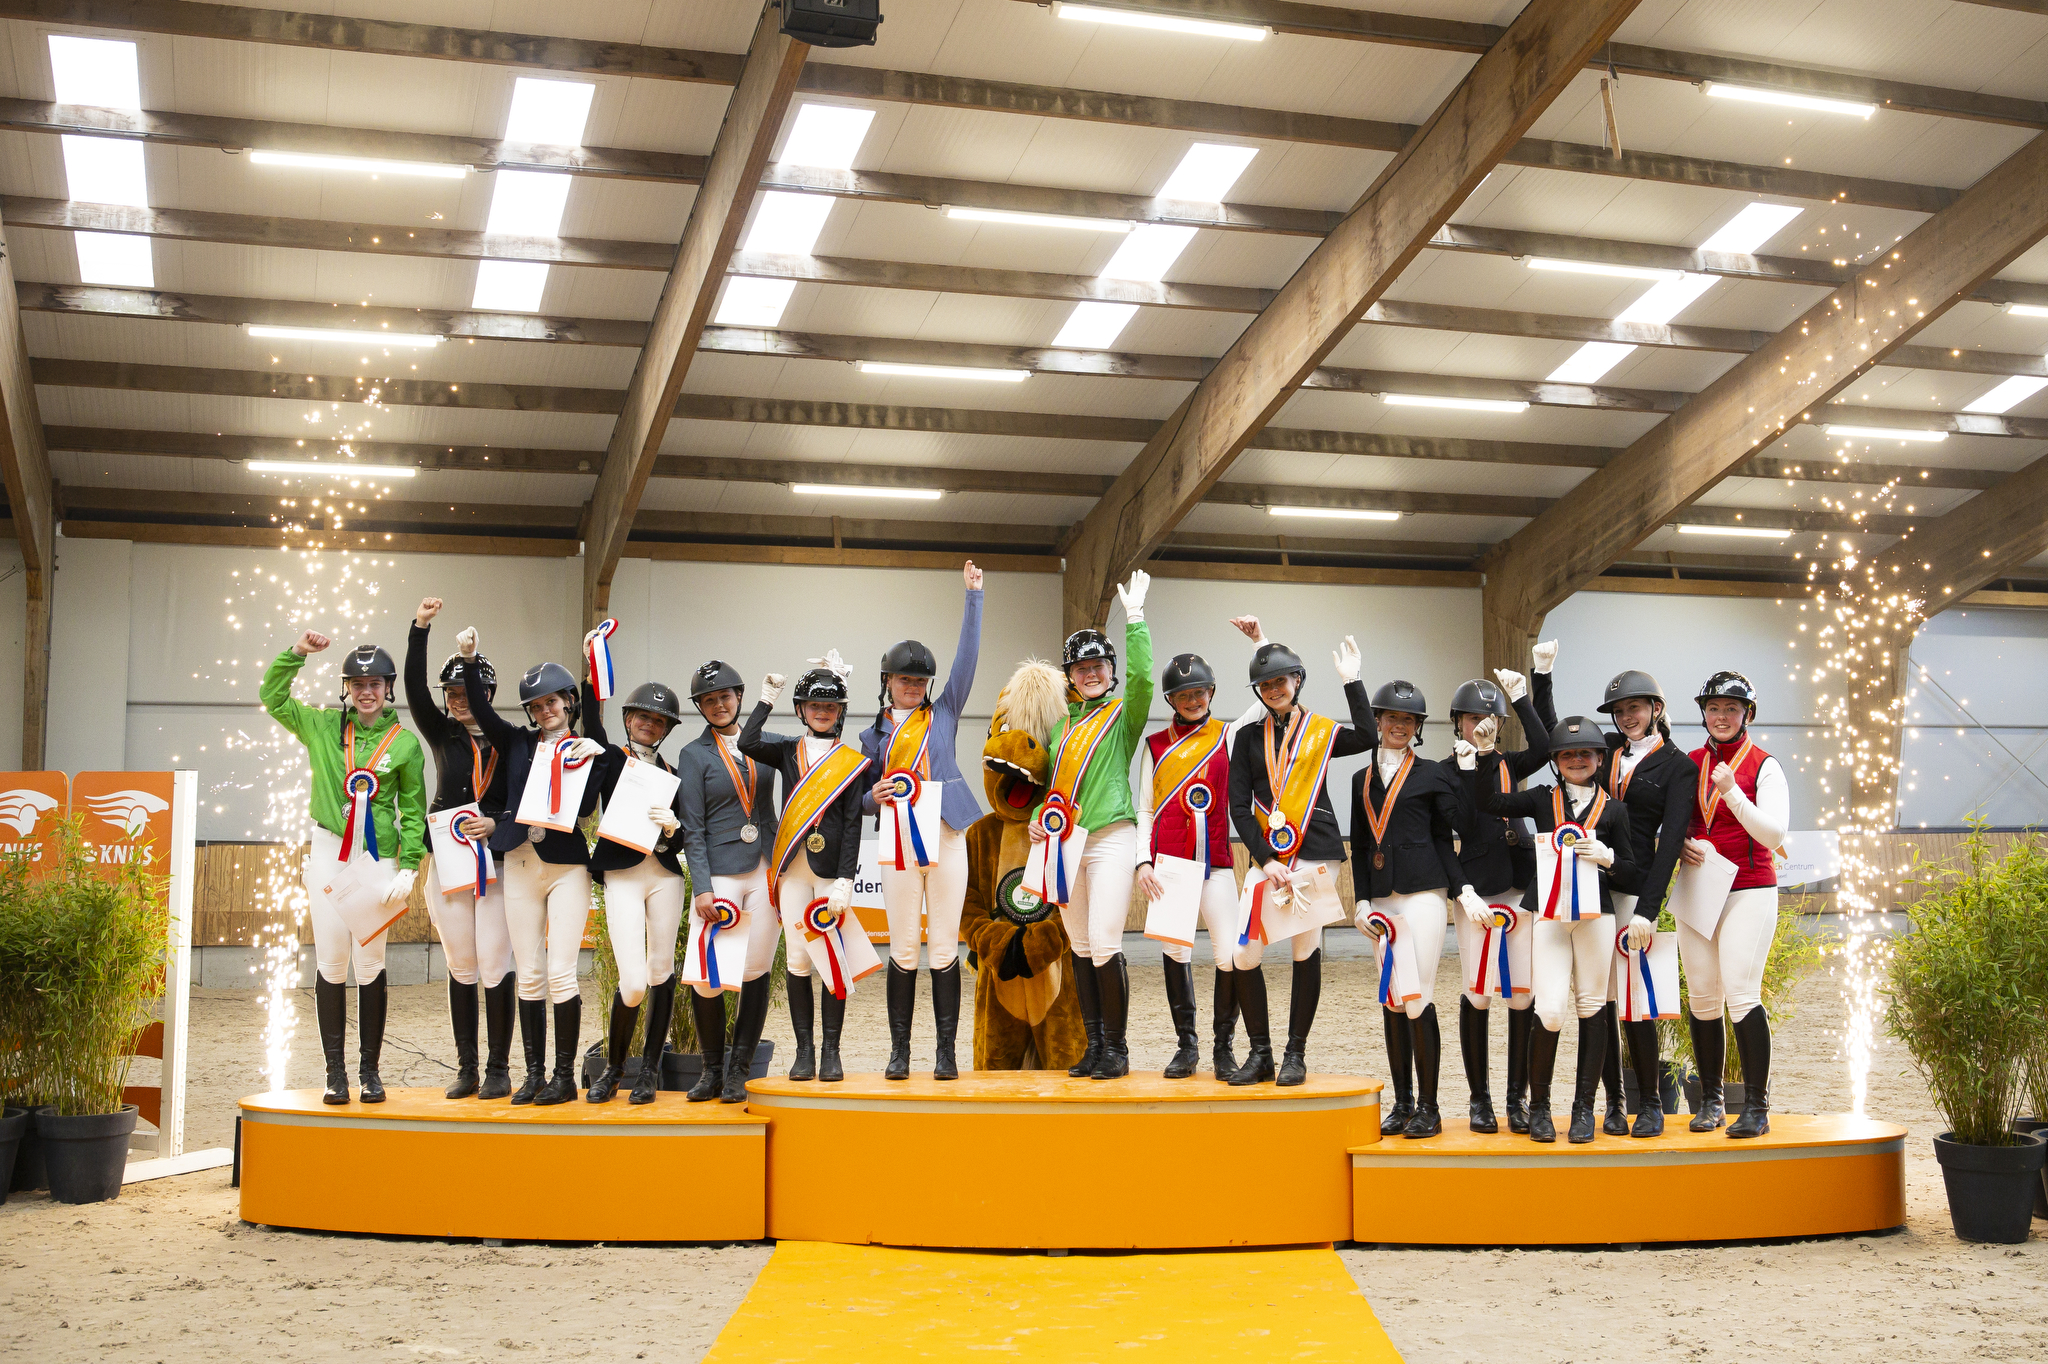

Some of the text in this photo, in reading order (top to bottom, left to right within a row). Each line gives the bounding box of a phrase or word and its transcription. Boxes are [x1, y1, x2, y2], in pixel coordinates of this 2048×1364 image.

[1178, 740, 1199, 759] Springen
[811, 786, 825, 801] 2026
[1784, 863, 1815, 871] Centrum
